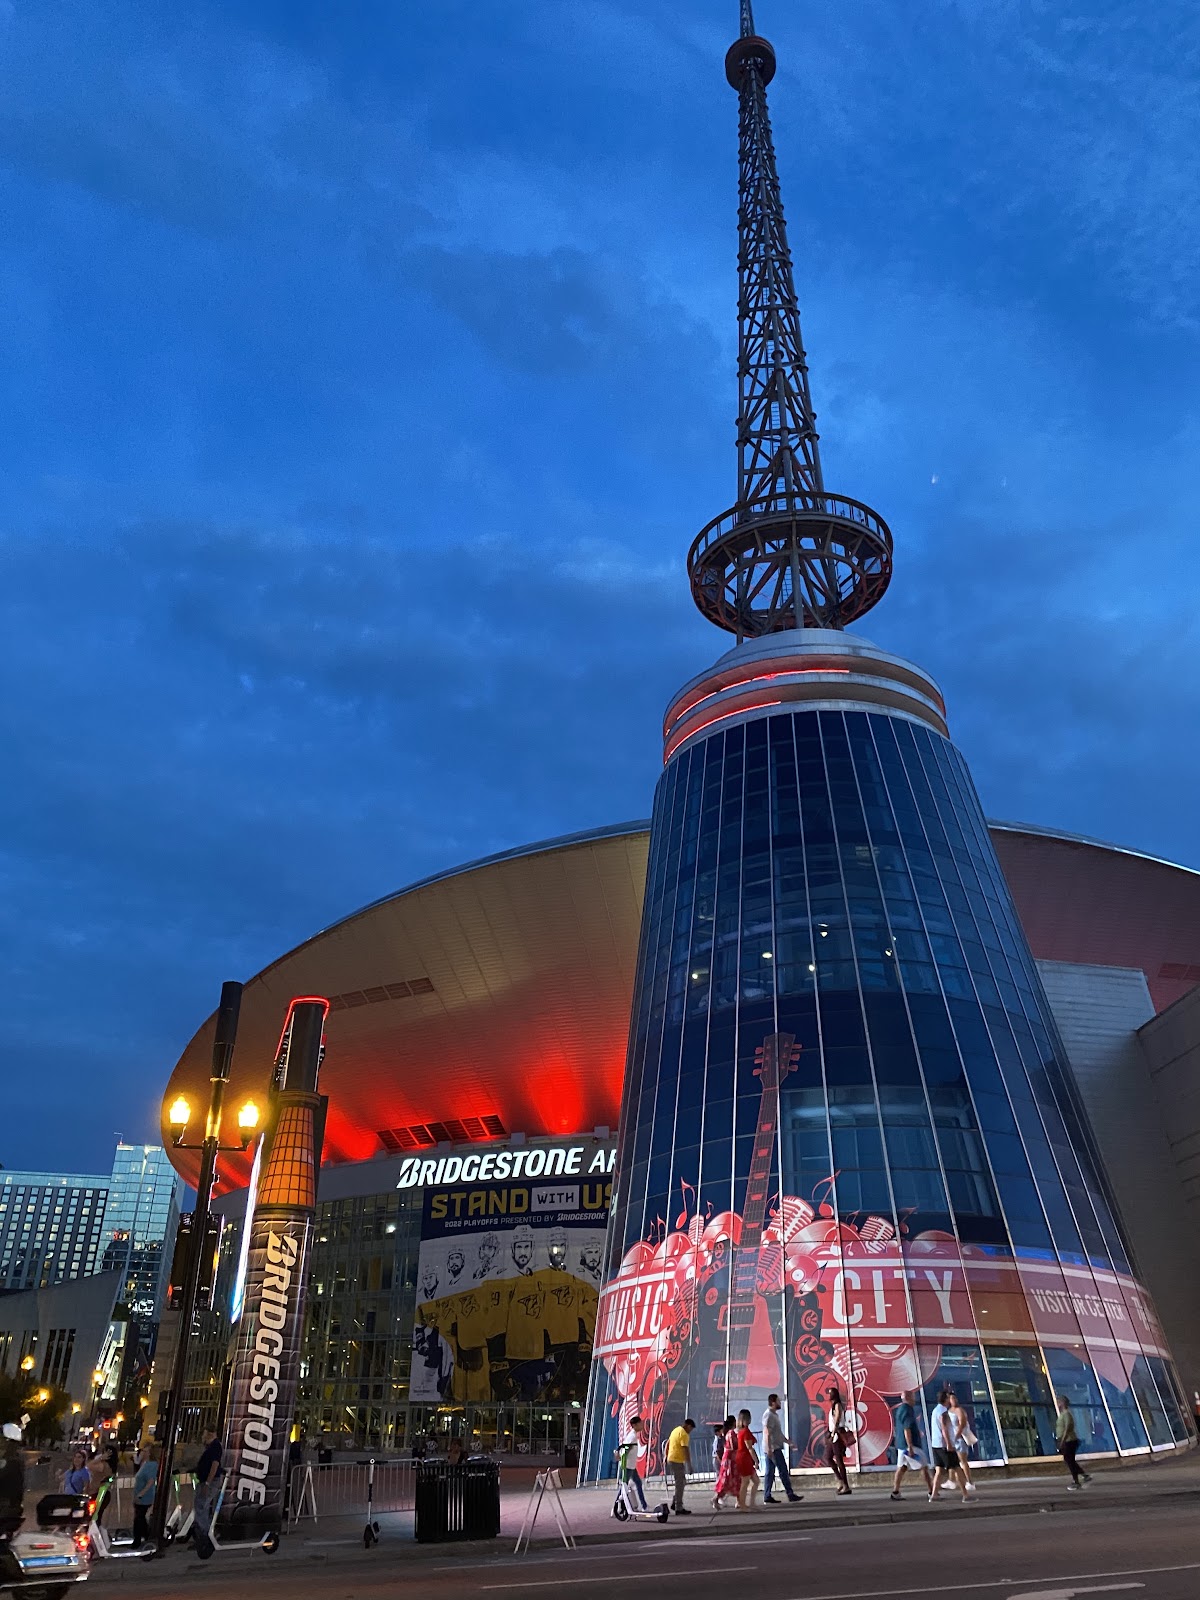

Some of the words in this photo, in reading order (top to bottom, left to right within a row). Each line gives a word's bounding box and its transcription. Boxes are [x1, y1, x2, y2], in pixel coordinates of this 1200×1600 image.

[396, 1147, 584, 1189] BRIDGESTONE
[430, 1188, 529, 1219] STAND
[537, 1191, 575, 1205] WITH
[444, 1220, 462, 1228] 2022
[463, 1218, 499, 1227] PLAYOFFS
[500, 1215, 542, 1225] PRESENTED
[556, 1212, 605, 1222] BRIDGESTONE
[604, 1282, 668, 1342] MUSIC
[833, 1269, 954, 1325] CITY
[1030, 1288, 1089, 1316] VISITOR
[1084, 1294, 1127, 1321] CENTER
[237, 1230, 298, 1506] BRIDGESTONE
